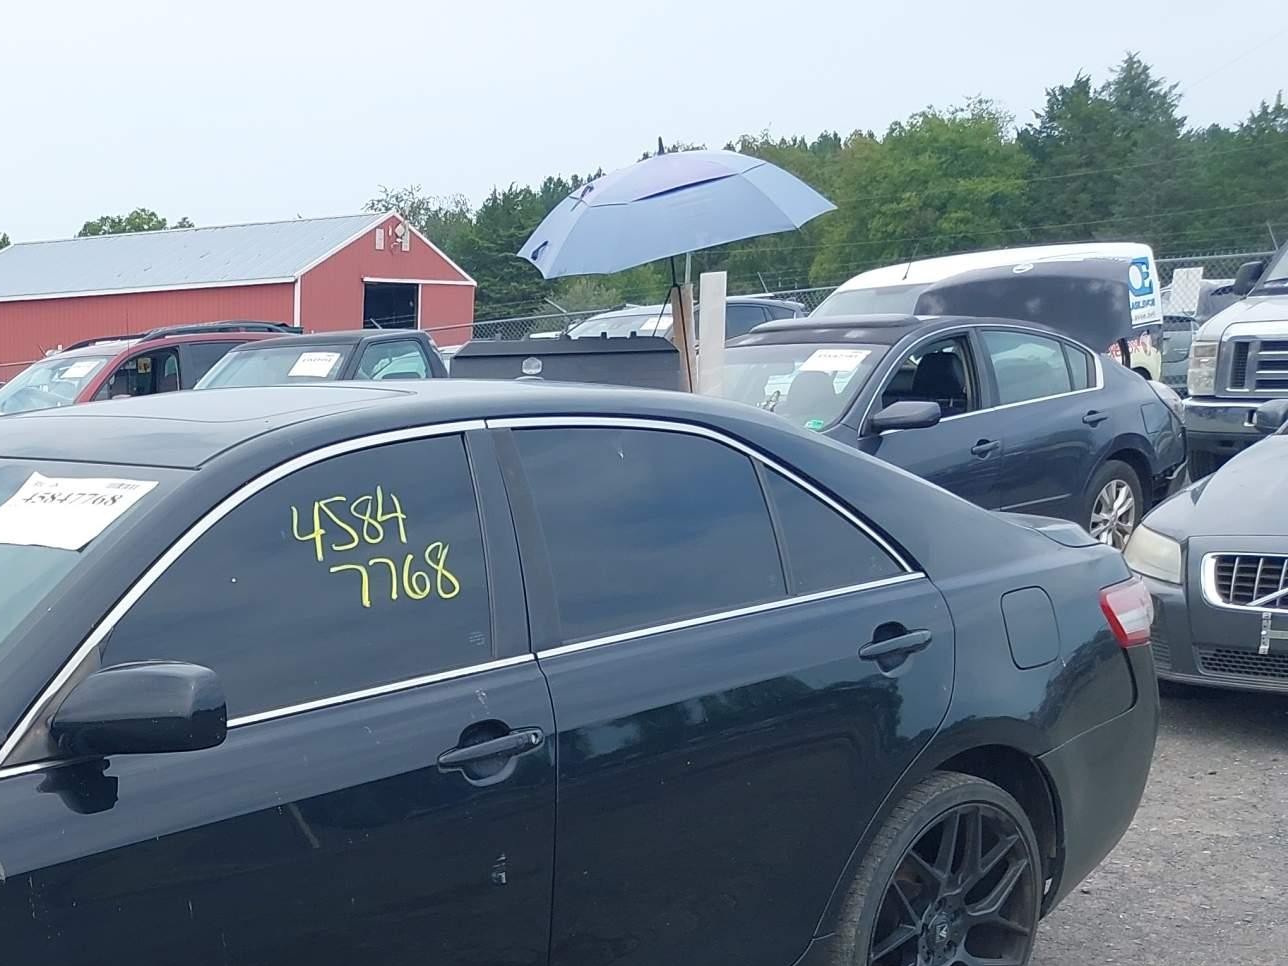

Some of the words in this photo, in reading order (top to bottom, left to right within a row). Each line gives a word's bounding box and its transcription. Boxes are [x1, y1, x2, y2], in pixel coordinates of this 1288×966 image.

[23, 491, 123, 506] 45847768
[291, 485, 407, 562] 4584
[329, 541, 460, 608] 7768
